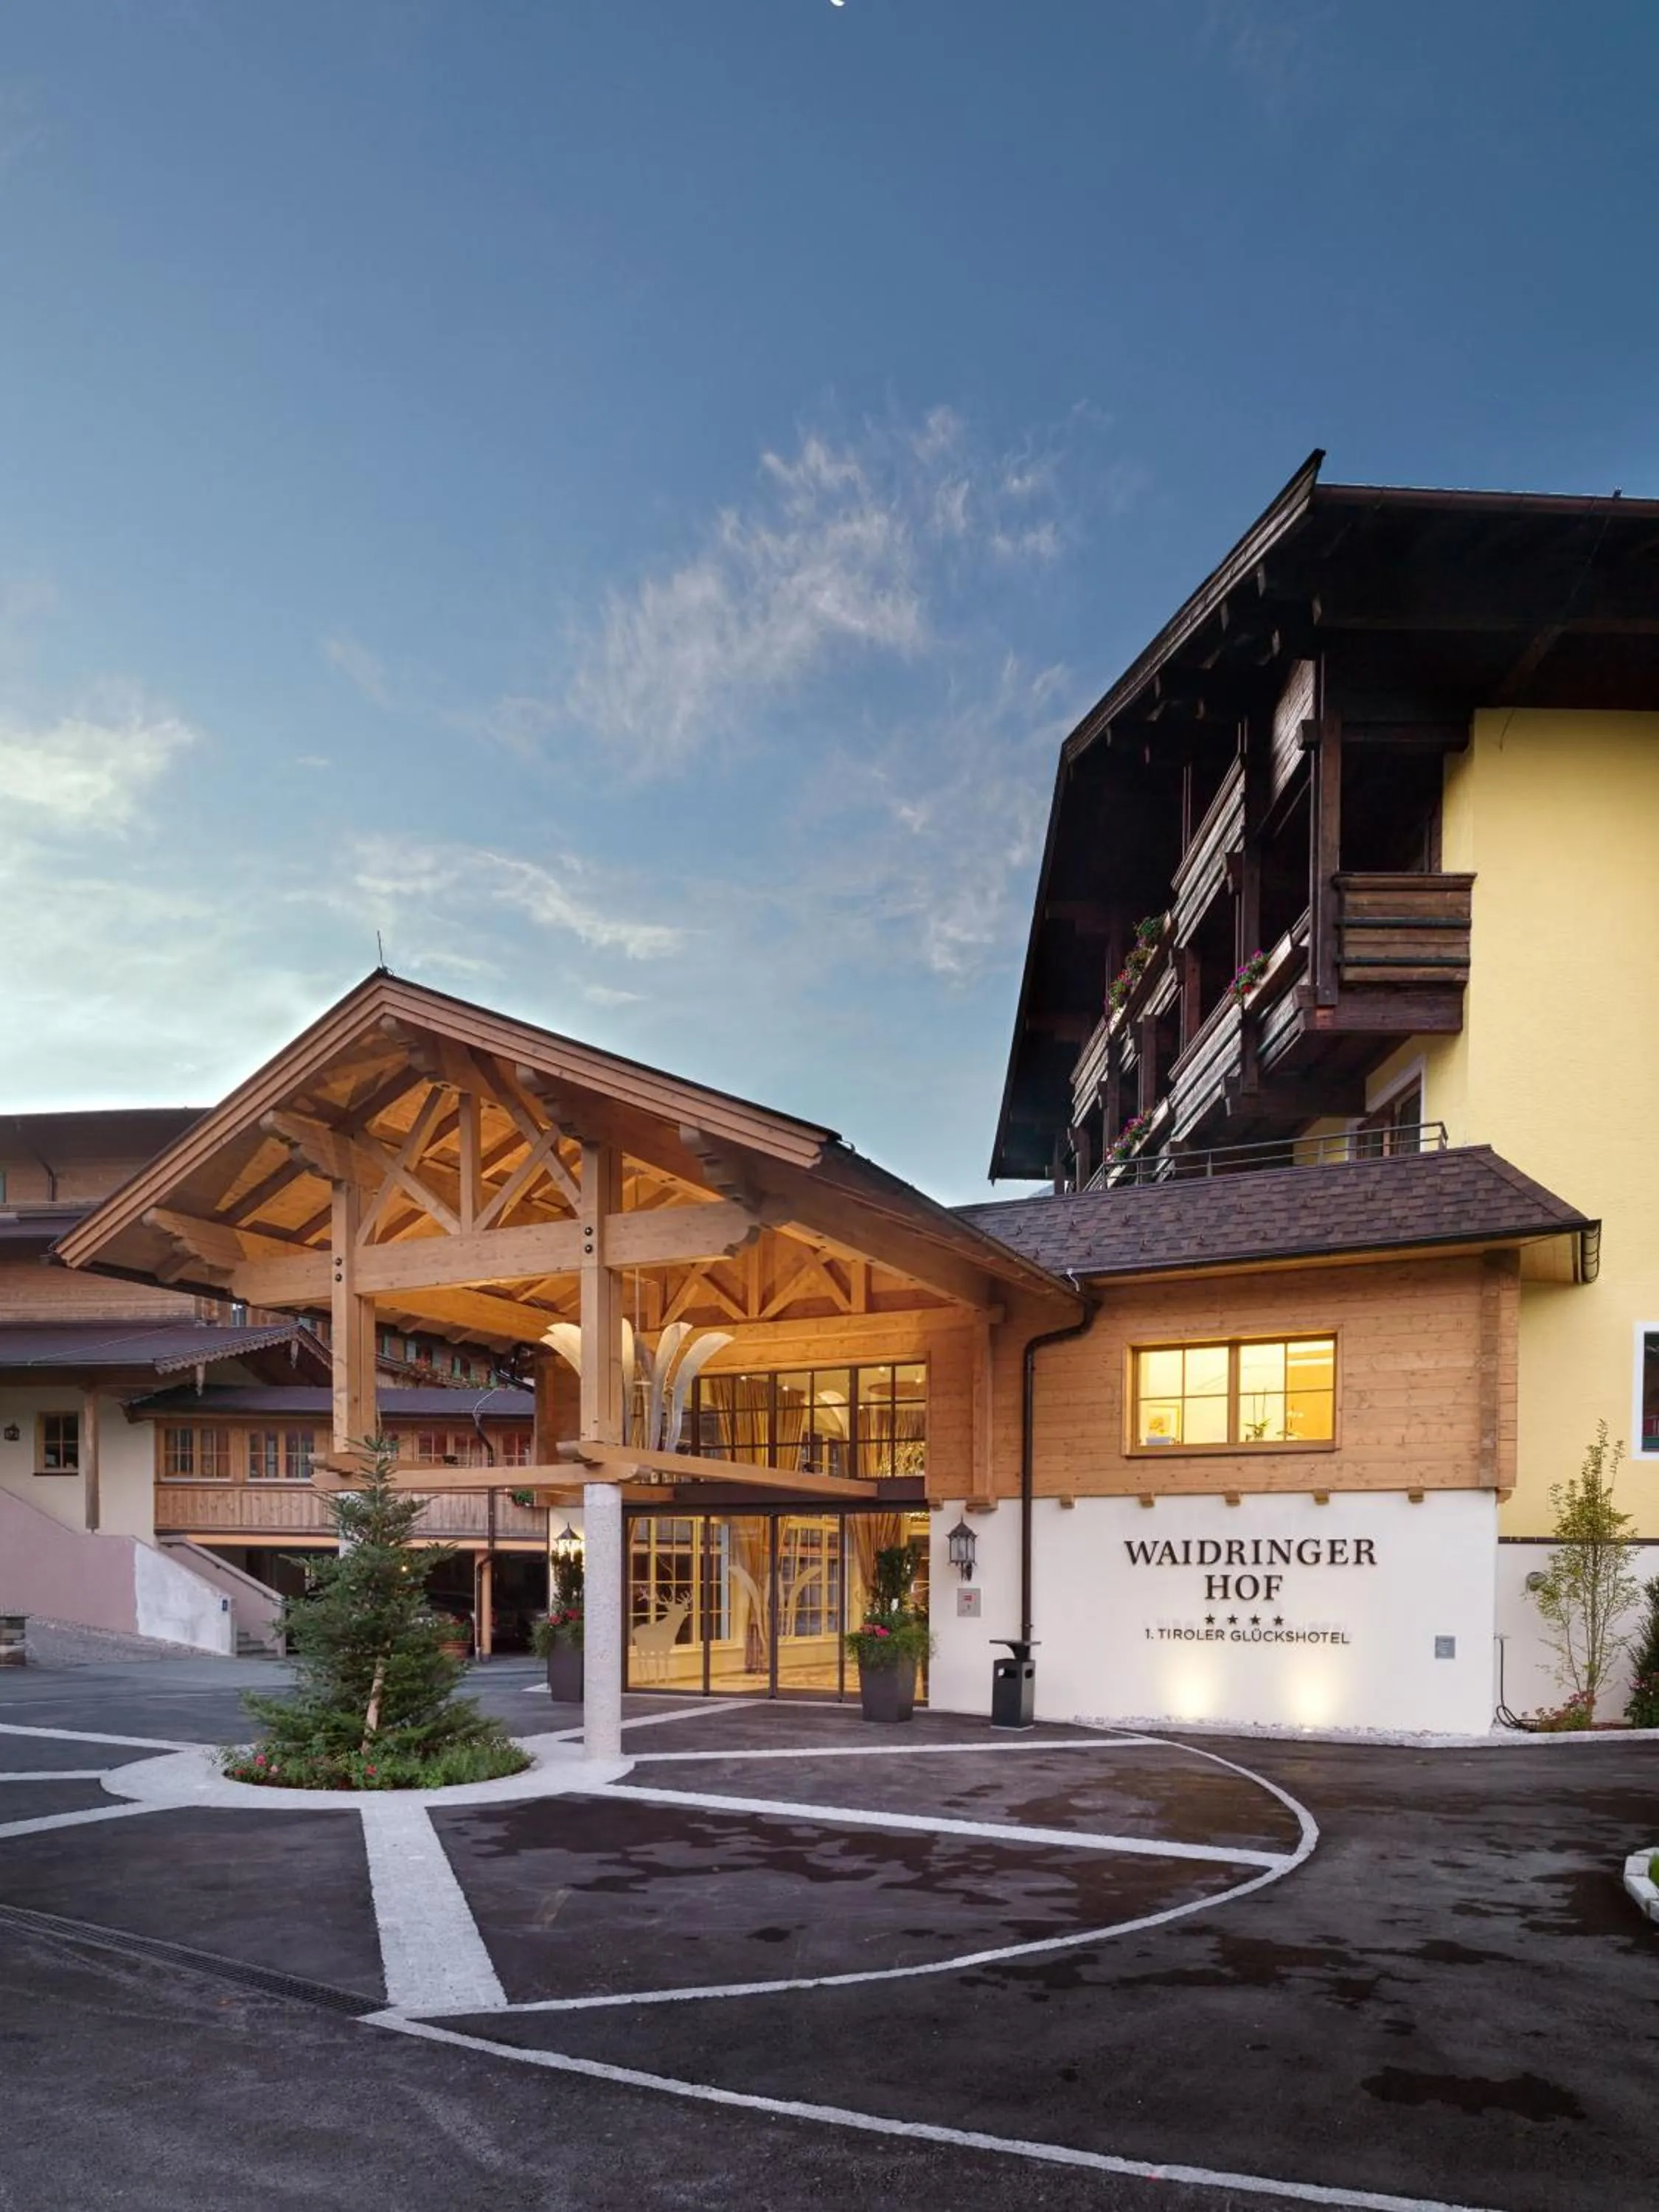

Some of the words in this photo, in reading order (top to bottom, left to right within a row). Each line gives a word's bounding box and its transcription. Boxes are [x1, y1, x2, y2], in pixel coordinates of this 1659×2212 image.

[1123, 1538, 1378, 1566] WAIDRINGER
[1204, 1573, 1284, 1601] HOF
[1145, 1628, 1154, 1640] 1.
[1158, 1628, 1225, 1641] TIROLER
[1231, 1628, 1351, 1644] GLÜCKSHOTEL
